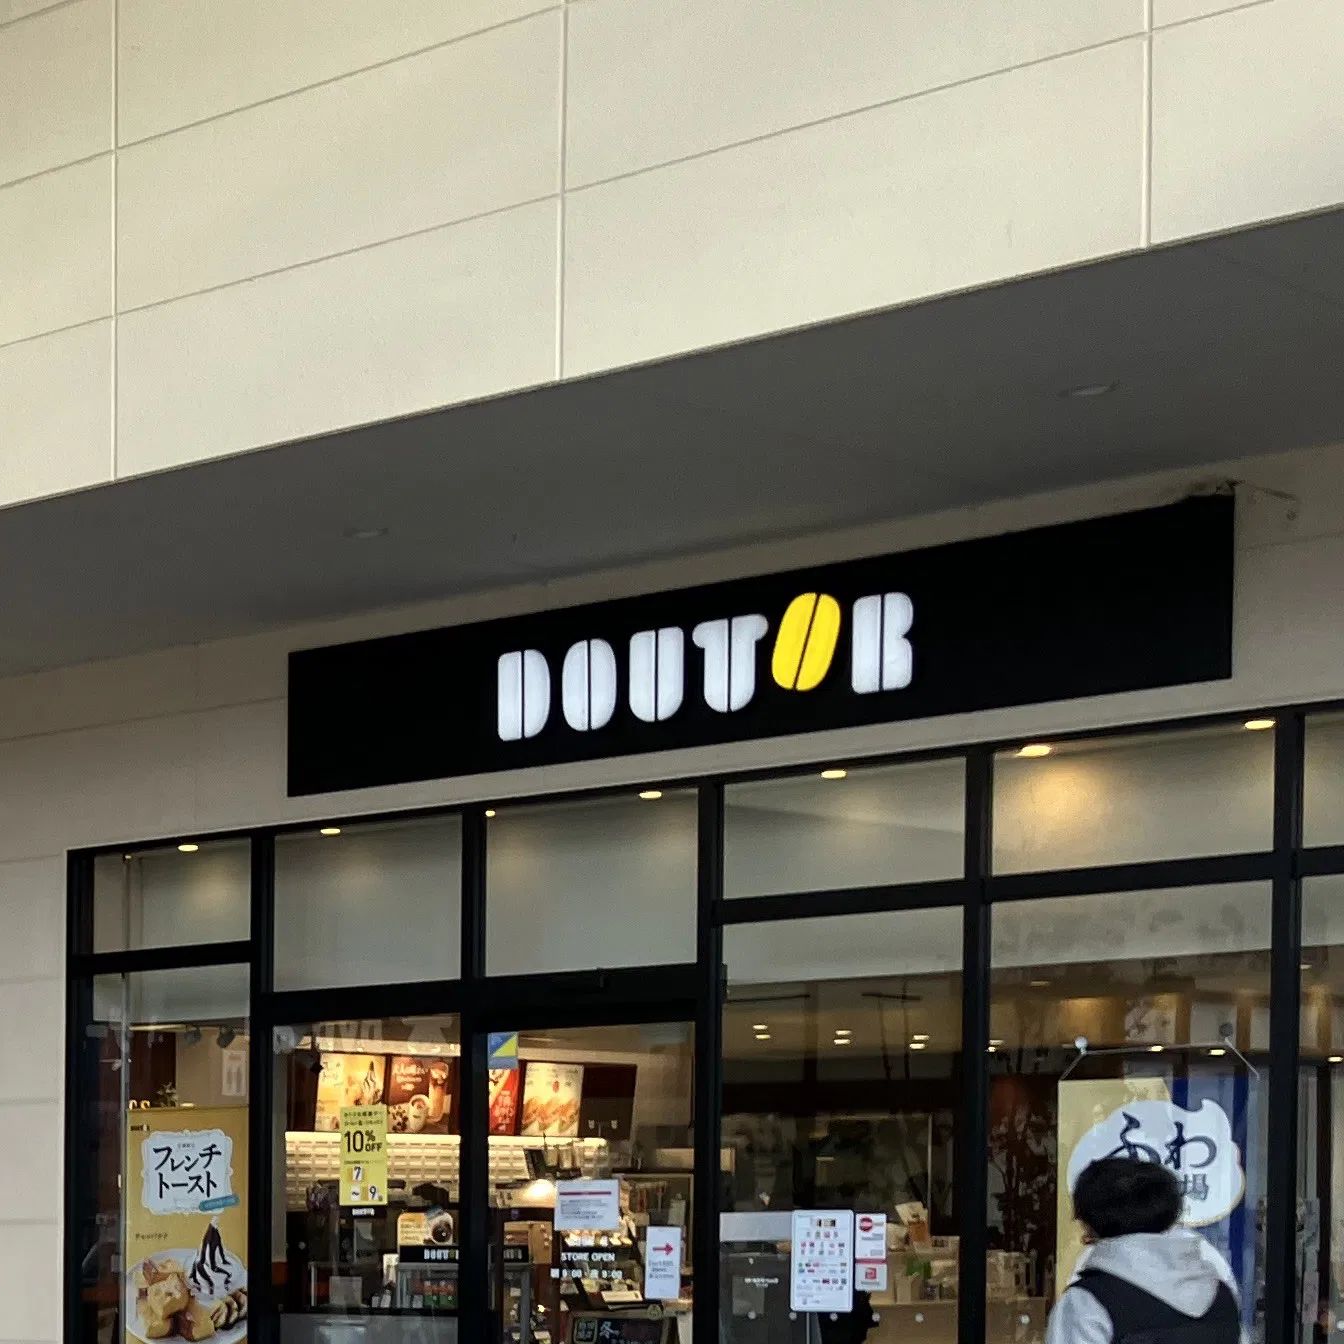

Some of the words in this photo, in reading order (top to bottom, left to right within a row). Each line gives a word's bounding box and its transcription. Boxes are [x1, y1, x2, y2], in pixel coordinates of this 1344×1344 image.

[498, 592, 914, 741] DOUTOR
[152, 1143, 222, 1173] フレンチ
[158, 1170, 217, 1199] トースト
[560, 1252, 590, 1261] STORE
[591, 1252, 616, 1261] OPEN
